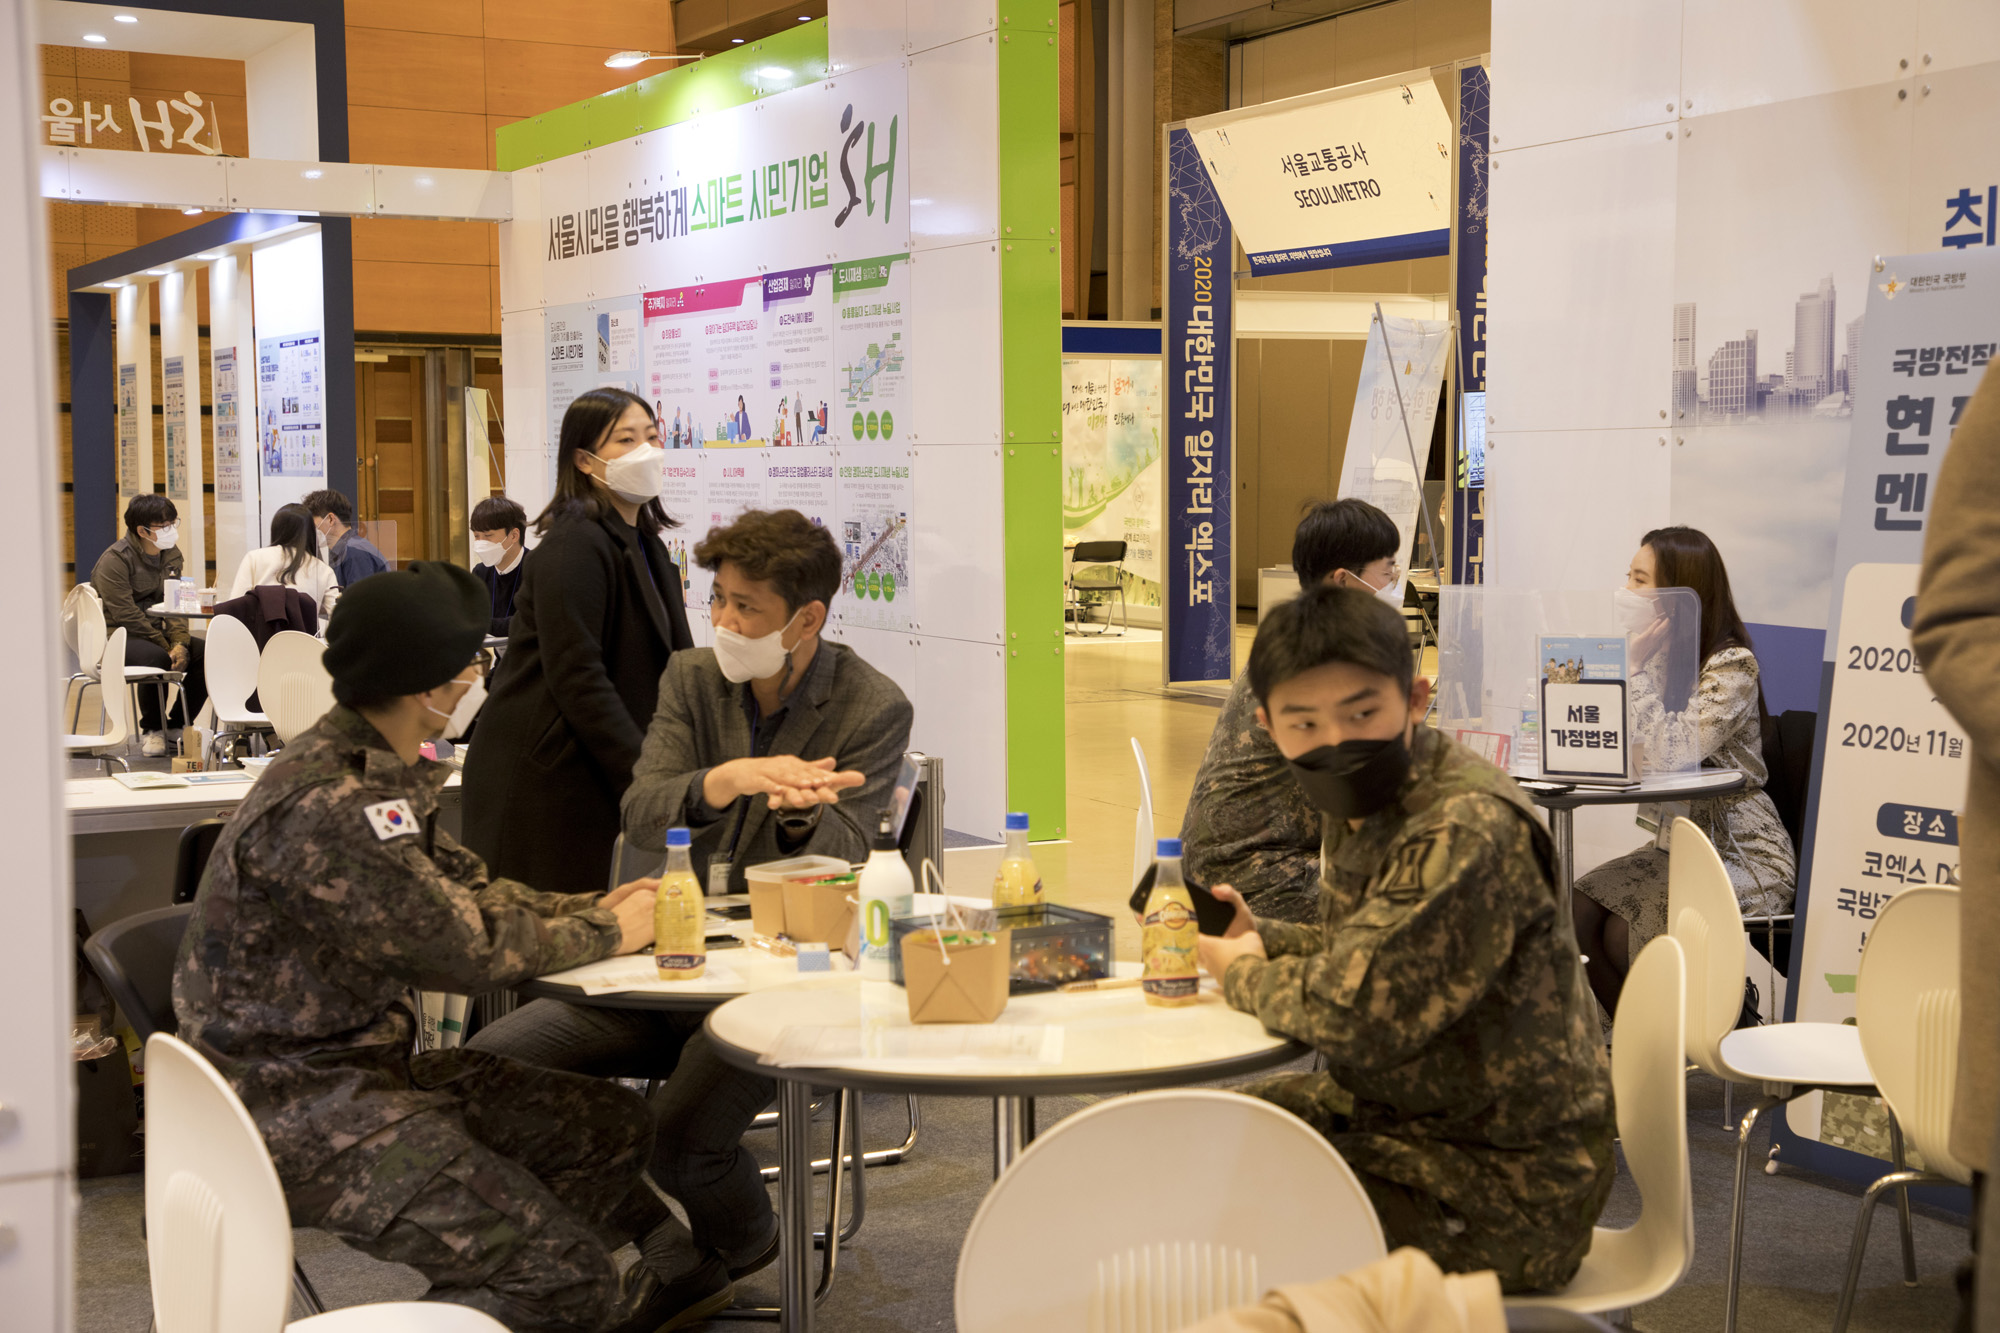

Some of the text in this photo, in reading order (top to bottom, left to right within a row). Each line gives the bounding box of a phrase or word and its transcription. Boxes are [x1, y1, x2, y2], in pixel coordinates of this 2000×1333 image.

[834, 103, 898, 228] SH
[1280, 142, 1369, 178] 서울교통공사
[548, 151, 829, 261] 서울시민을 행복하게 스마트 시민기업
[1294, 178, 1381, 209] SEOULMETRO
[768, 277, 788, 293] 산업경제
[839, 266, 862, 284] 도시재생
[1910, 275, 1940, 287] 대한민국
[1893, 343, 1999, 378] 국방전직
[1185, 431, 1214, 514] 일자리
[1185, 522, 1213, 606] 엑스포
[1567, 705, 1600, 723] 서울
[1551, 729, 1618, 749] 가정법원
[1842, 722, 1963, 758] 2020년 11월
[1862, 851, 1926, 883] 코엑스
[1837, 888, 1893, 919] 국방
